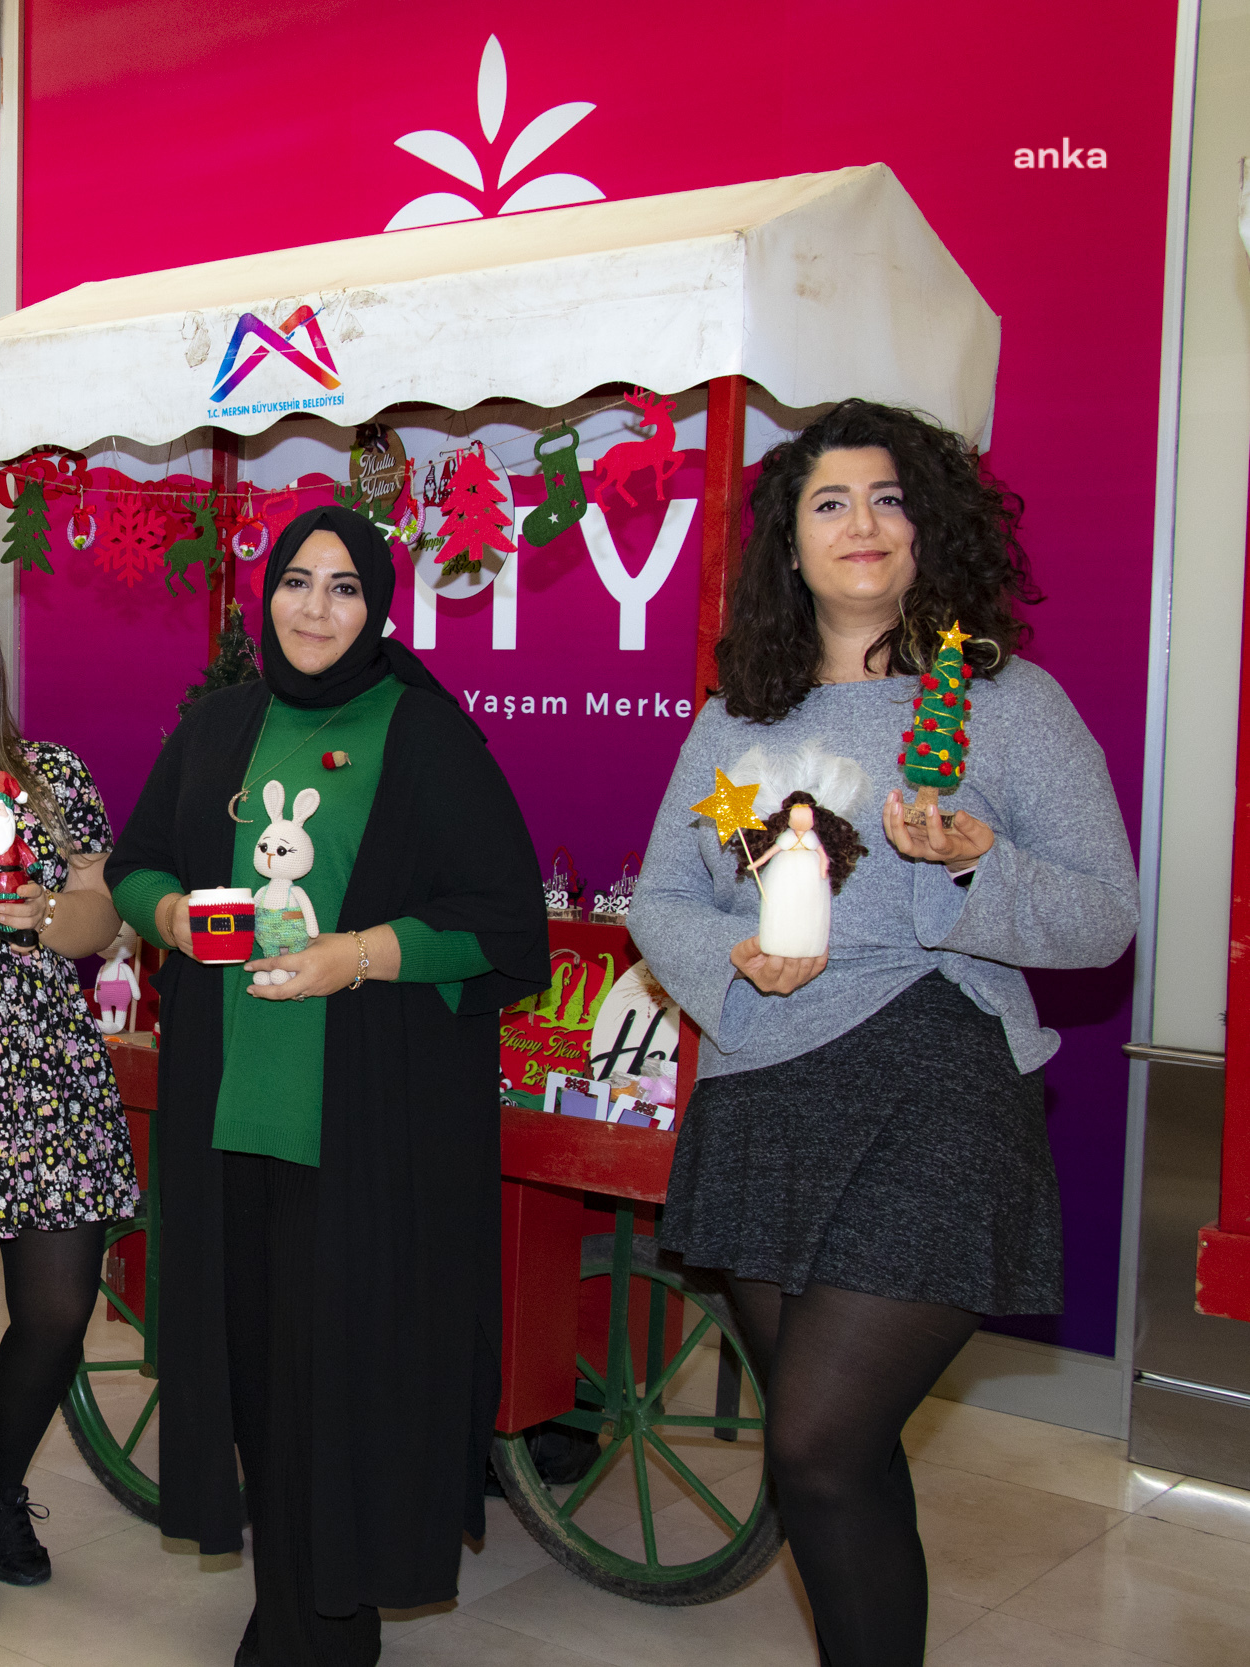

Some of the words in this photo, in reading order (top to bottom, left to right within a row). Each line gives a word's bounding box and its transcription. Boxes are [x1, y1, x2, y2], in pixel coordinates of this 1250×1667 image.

[463, 690, 568, 720] Yaşam
[585, 692, 692, 718] Merke
[500, 1025, 543, 1056] Happy
[543, 1034, 581, 1059] New
